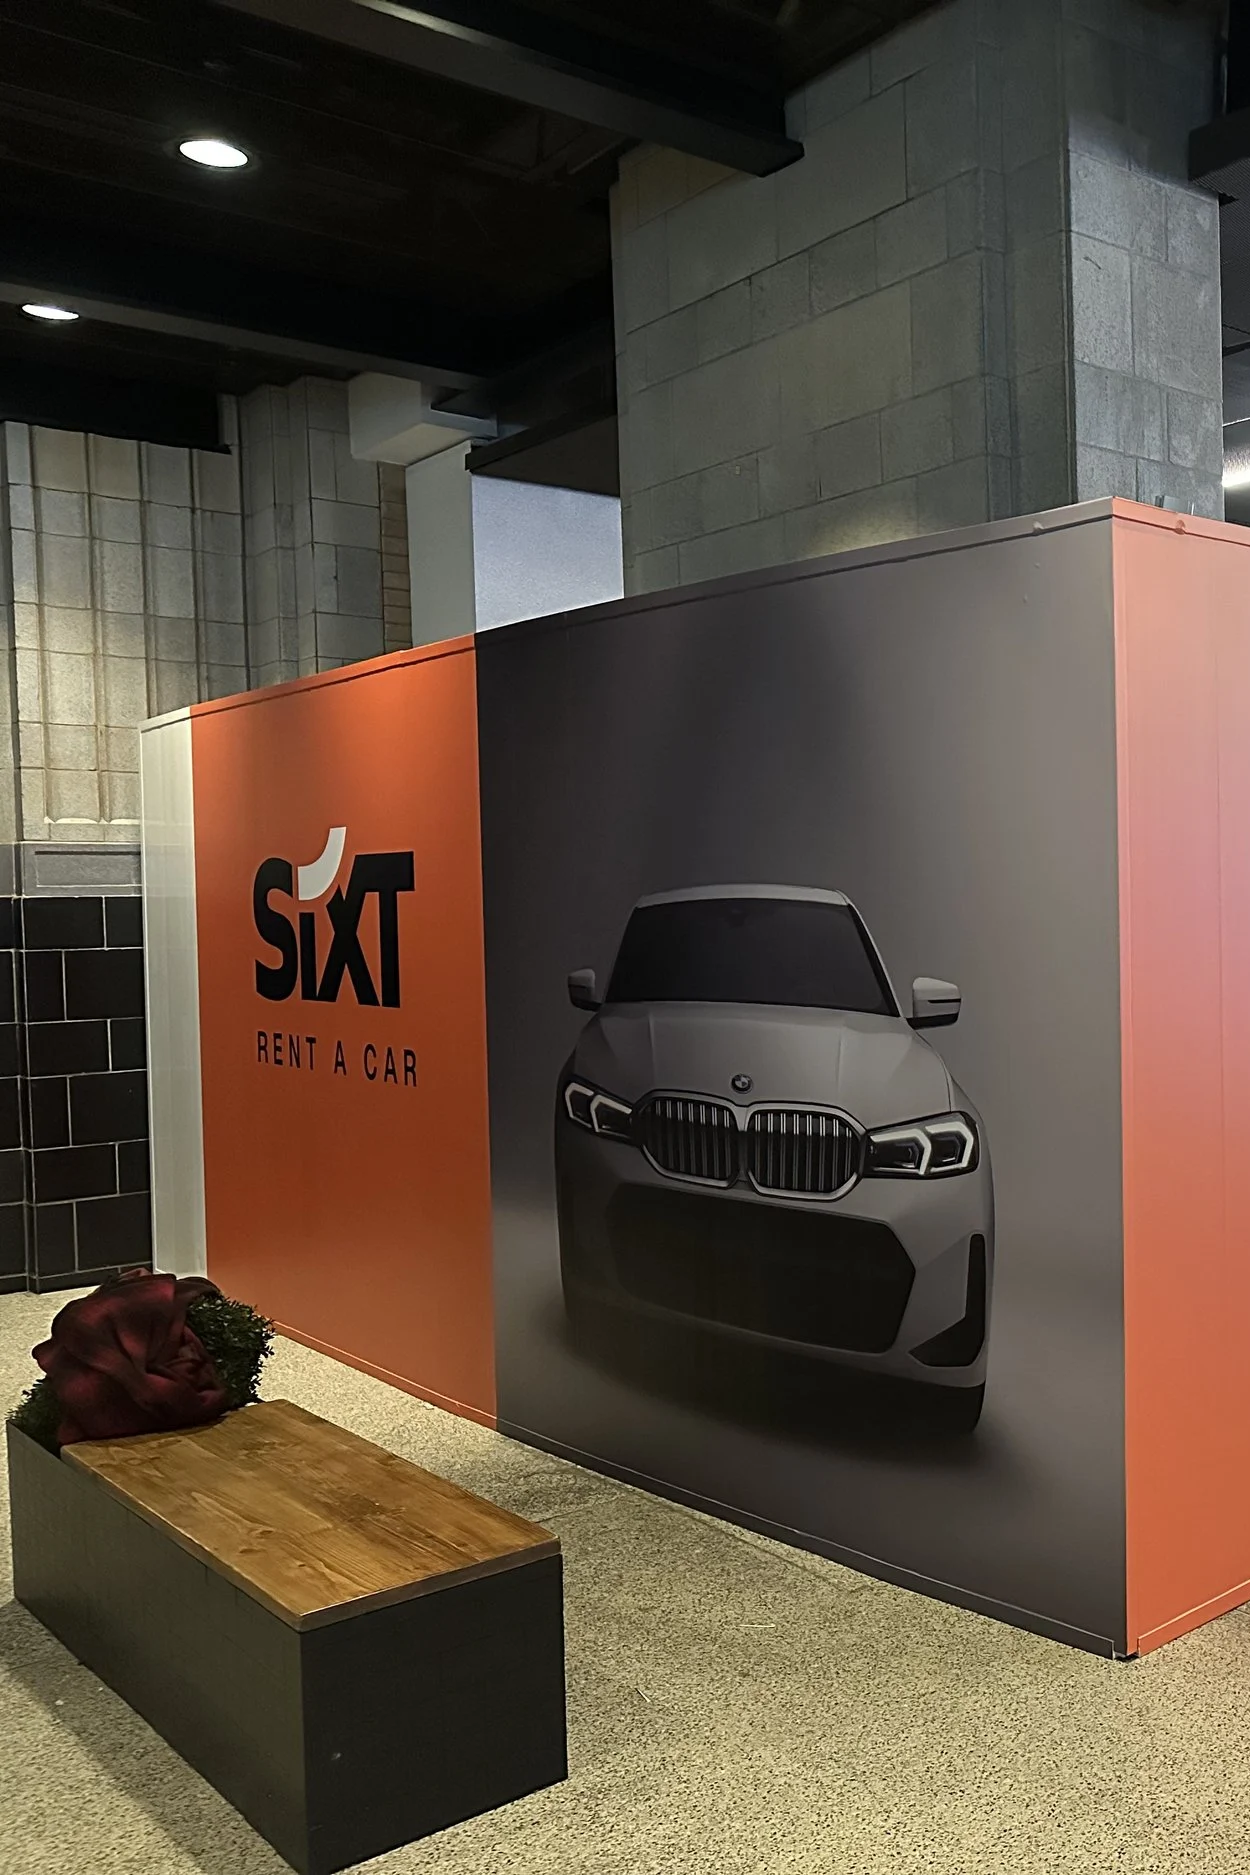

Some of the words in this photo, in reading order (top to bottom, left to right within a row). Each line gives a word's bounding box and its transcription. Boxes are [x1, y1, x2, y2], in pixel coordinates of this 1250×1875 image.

[257, 1031, 316, 1071] RENT
[333, 1040, 347, 1076] A
[363, 1043, 417, 1087] CAR
